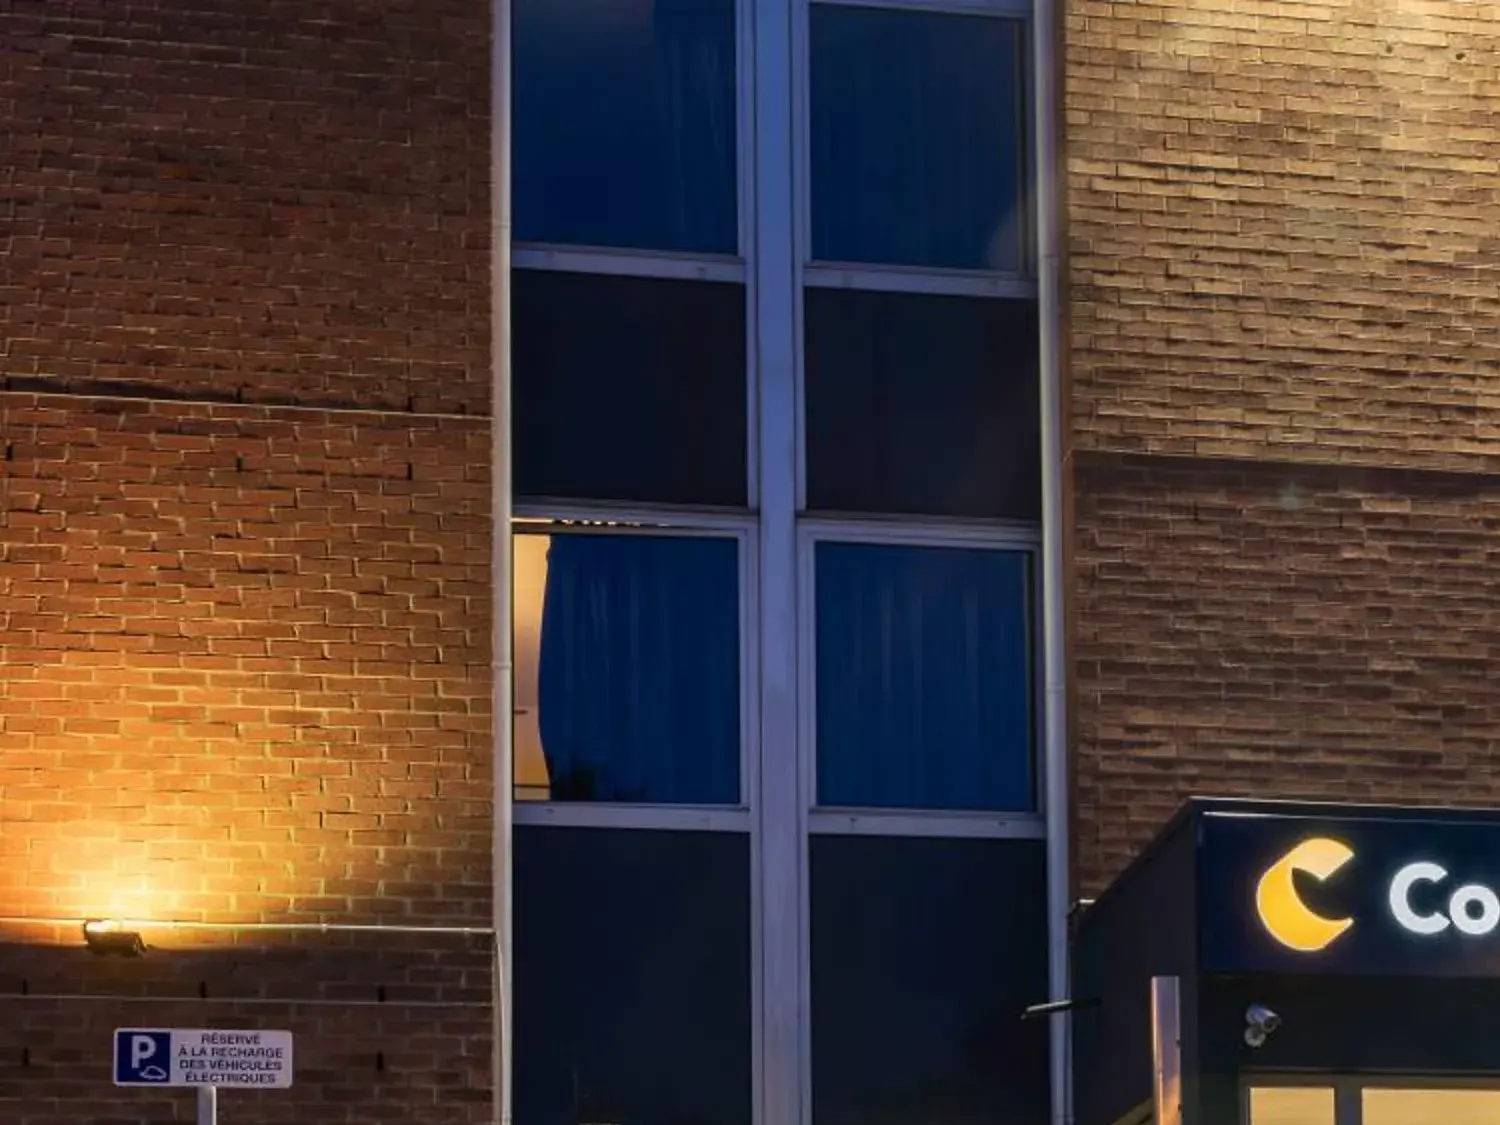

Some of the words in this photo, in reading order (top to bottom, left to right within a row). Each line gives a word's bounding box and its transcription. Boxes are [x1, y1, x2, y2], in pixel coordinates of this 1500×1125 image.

[131, 1035, 157, 1069] P
[191, 1047, 207, 1057] LA
[211, 1047, 284, 1058] RECHARGE
[179, 1060, 206, 1070] DES
